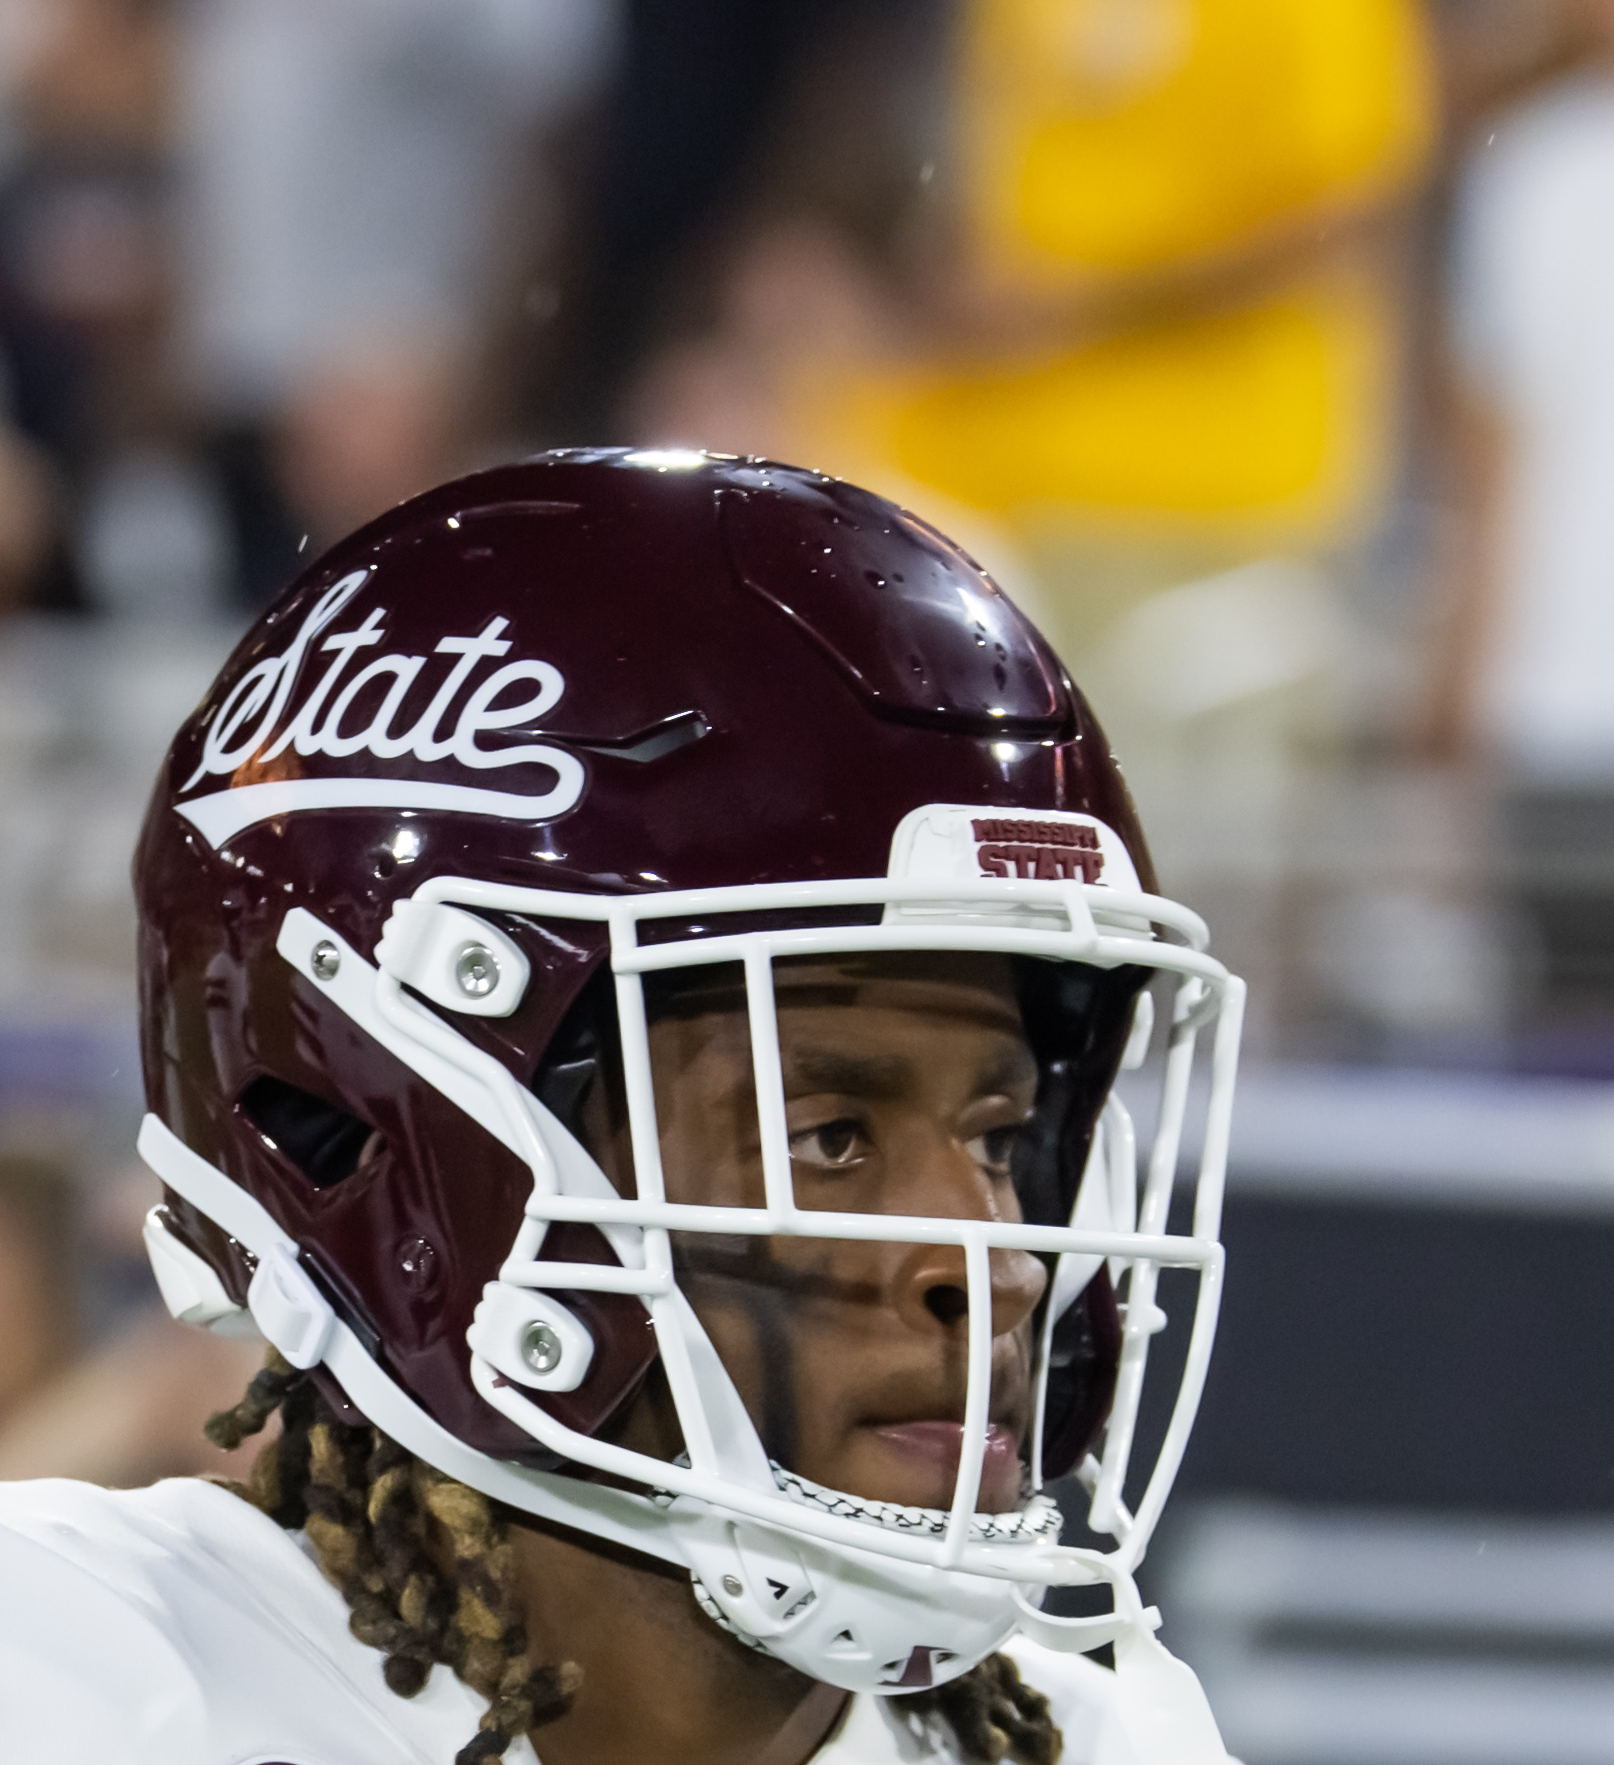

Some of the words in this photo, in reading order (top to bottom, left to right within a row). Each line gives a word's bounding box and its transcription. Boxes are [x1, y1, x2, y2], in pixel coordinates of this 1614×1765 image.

[175, 569, 585, 822] State
[970, 818, 1101, 851] MISSISSIPP
[977, 844, 1106, 885] STATE
